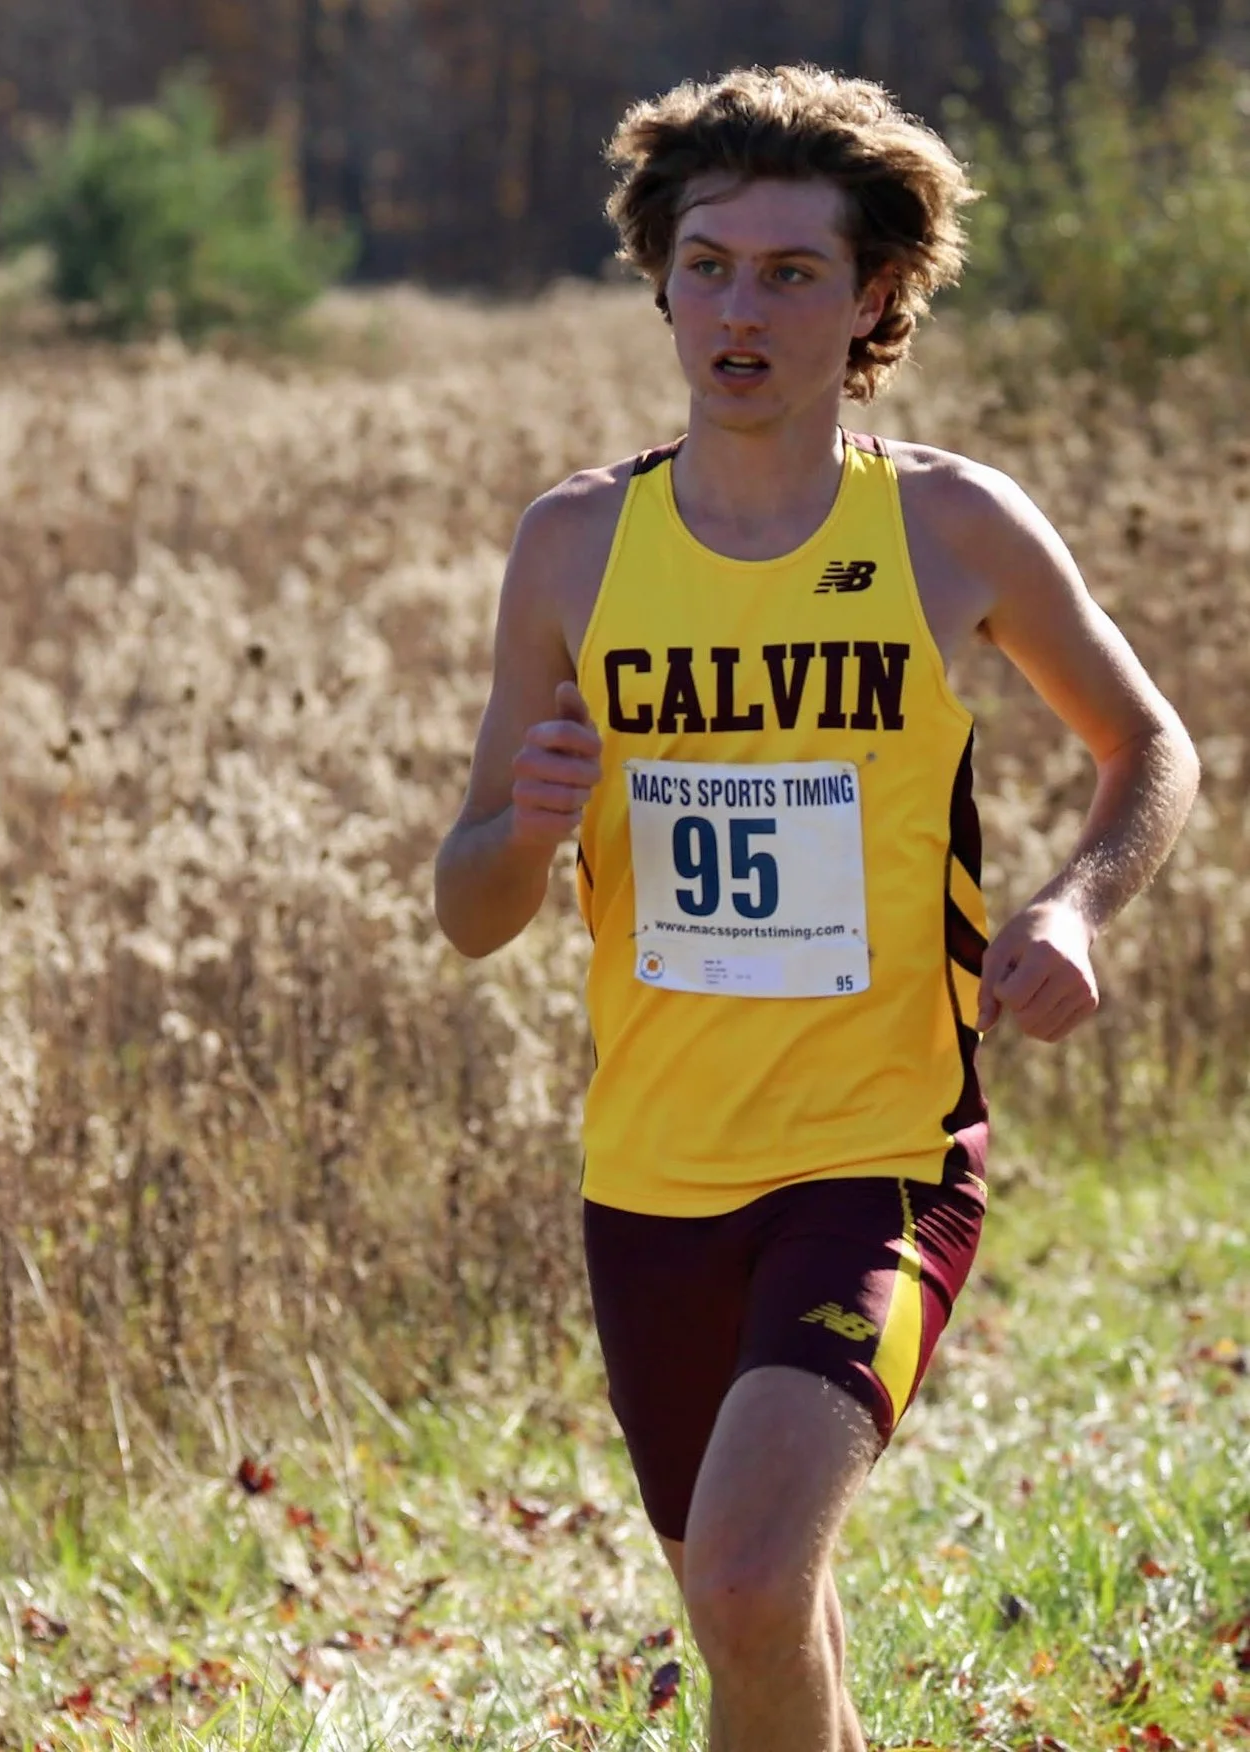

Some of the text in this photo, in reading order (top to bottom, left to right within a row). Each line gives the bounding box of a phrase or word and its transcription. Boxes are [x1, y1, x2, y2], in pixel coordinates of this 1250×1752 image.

[814, 561, 877, 594] NB
[604, 641, 910, 734] CALVIN
[632, 772, 855, 808] MAC'S SPORTS TIMING
[671, 815, 780, 919] 95
[654, 920, 845, 940] www.macssportstiming.com
[836, 975, 854, 992] 95
